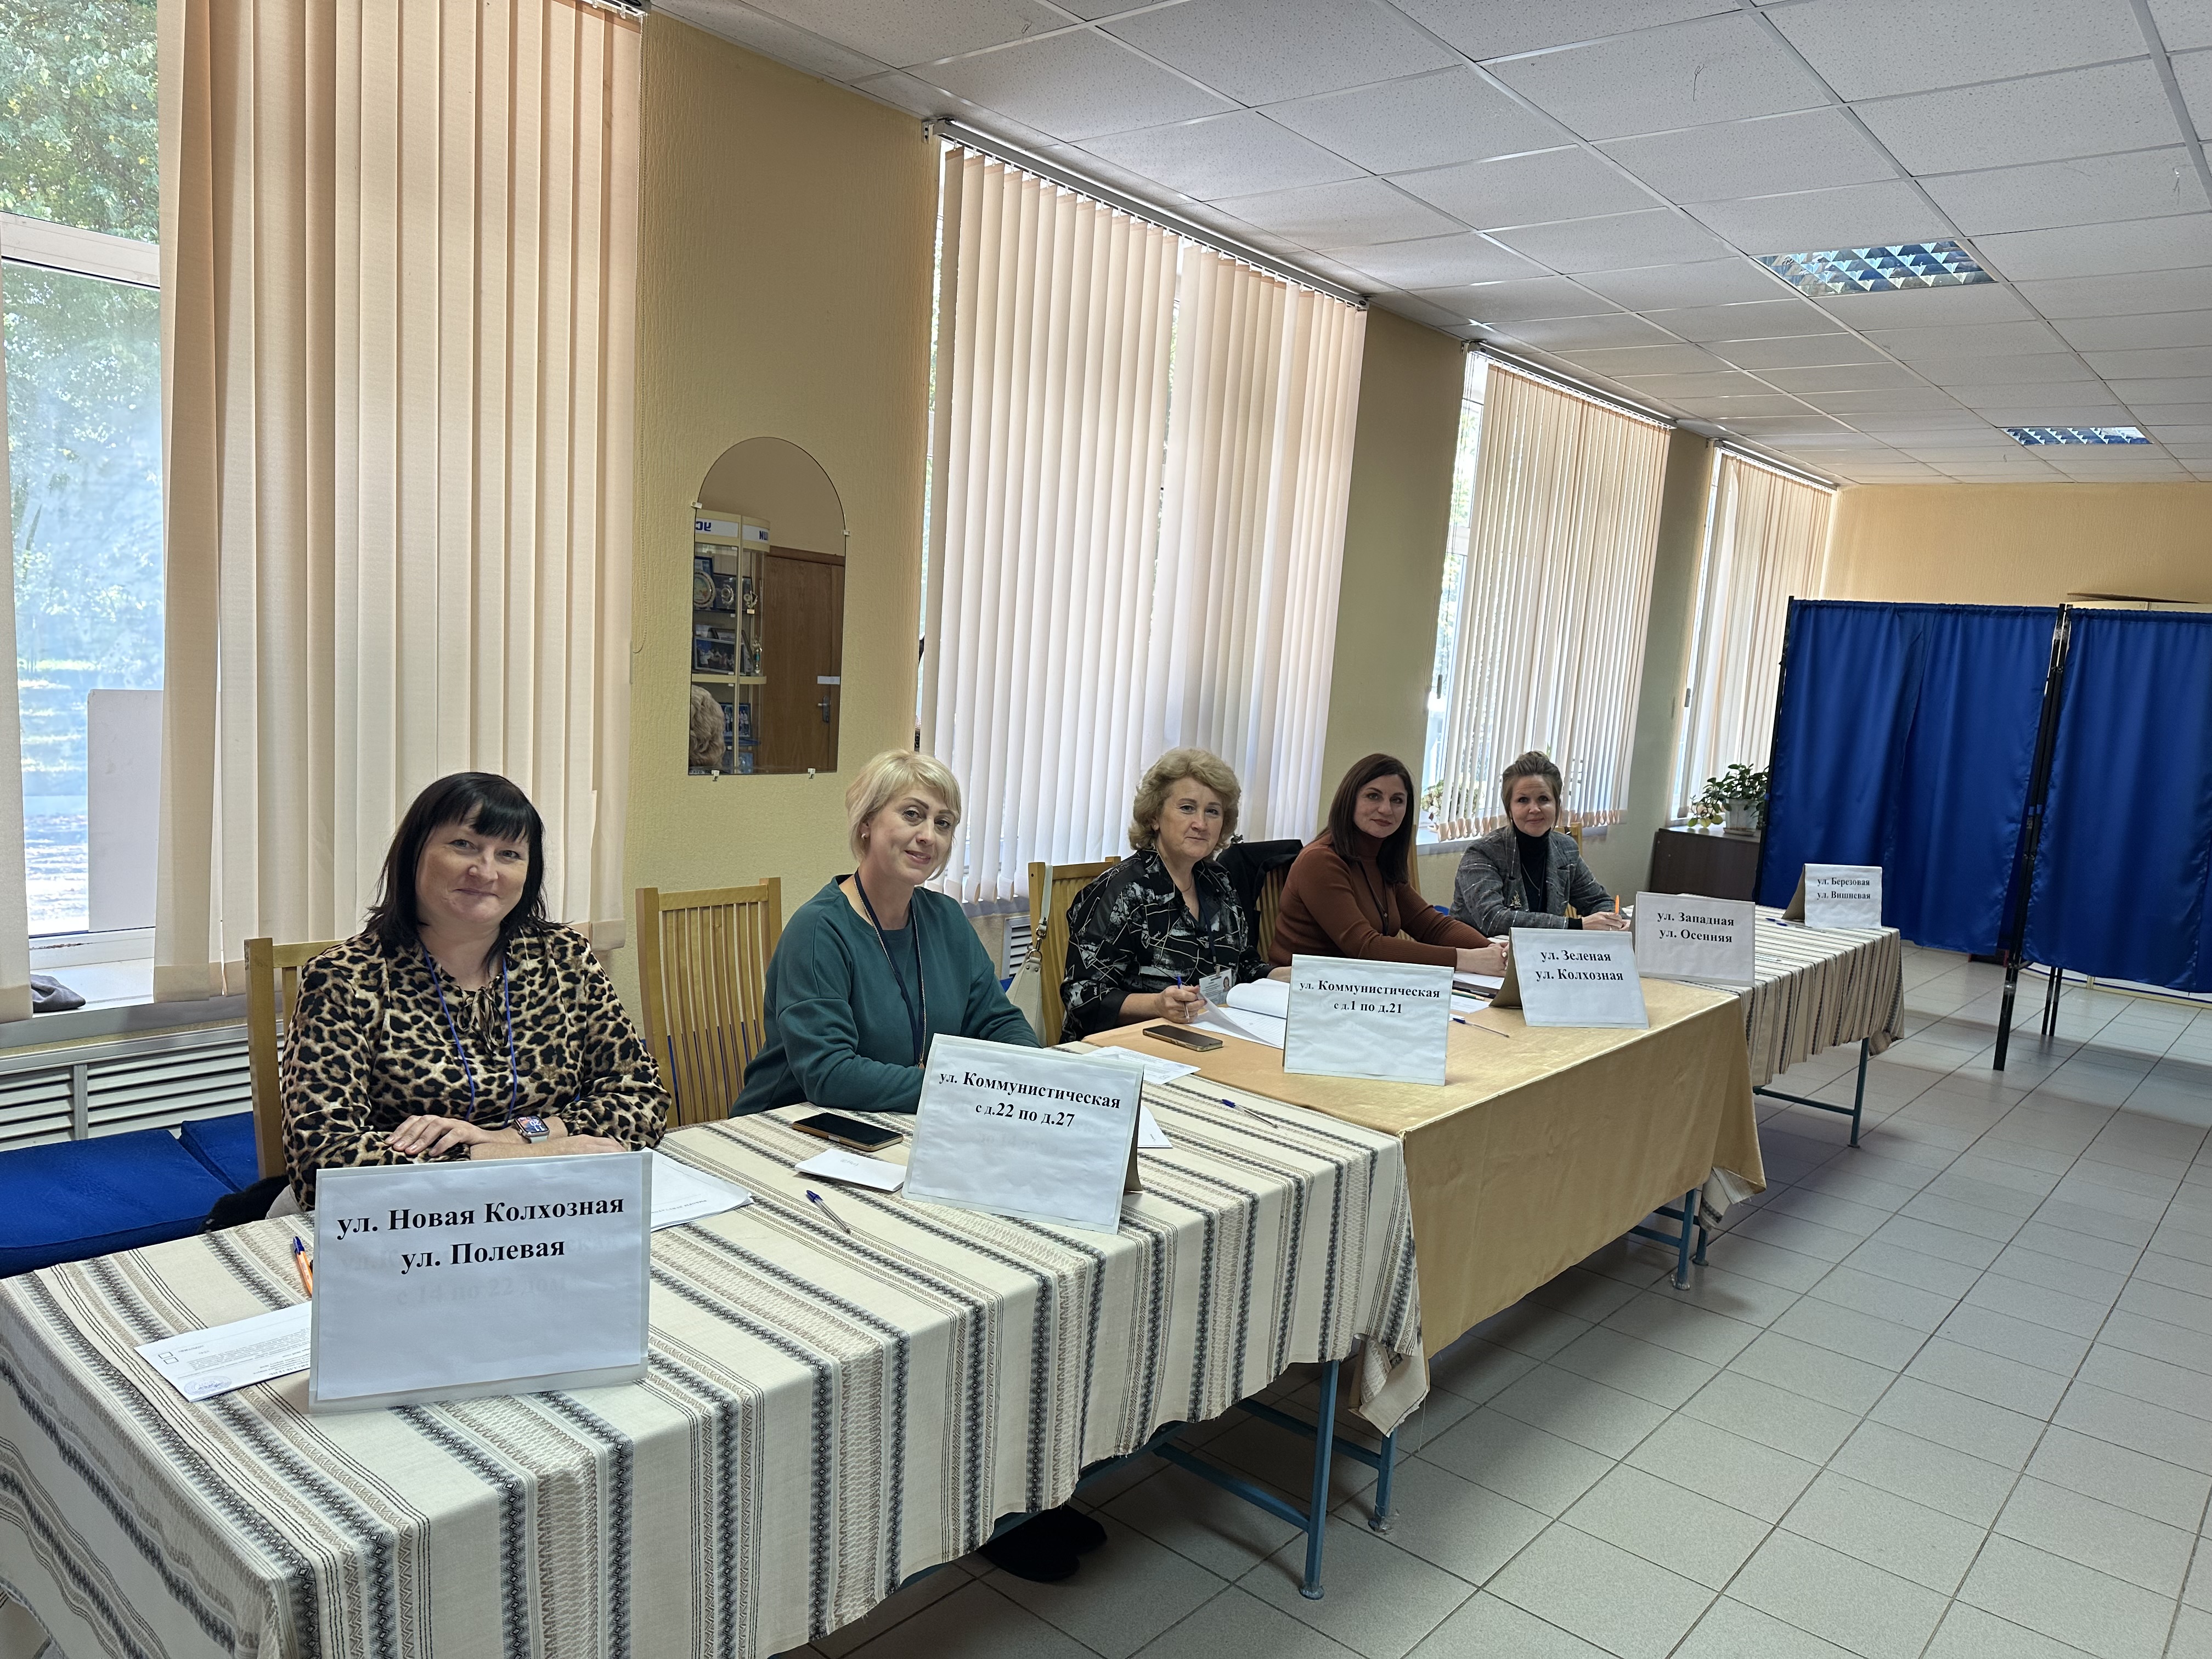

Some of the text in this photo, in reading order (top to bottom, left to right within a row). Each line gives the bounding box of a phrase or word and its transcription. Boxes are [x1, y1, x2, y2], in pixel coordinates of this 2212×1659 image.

[1832, 878, 1869, 887] Березовая
[1657, 912, 1734, 926] ул. Западная
[1660, 929, 1731, 942] ул. Осенняя
[1541, 950, 1611, 962] ул. Зеленая
[1536, 969, 1623, 981] ул. Колхозная
[1319, 980, 1440, 997] Коммунистическая
[1341, 1001, 1355, 1010] д.1
[1378, 1003, 1401, 1013] д.21
[939, 1072, 1120, 1109] ул. Коммунистическая
[984, 1103, 1014, 1118] д.22
[1019, 1110, 1037, 1121] по
[1041, 1112, 1075, 1127] д.27
[337, 1199, 623, 1240] ул. Новая Колхозная
[402, 1252, 440, 1274] ул.
[450, 1242, 565, 1265] Полевая
